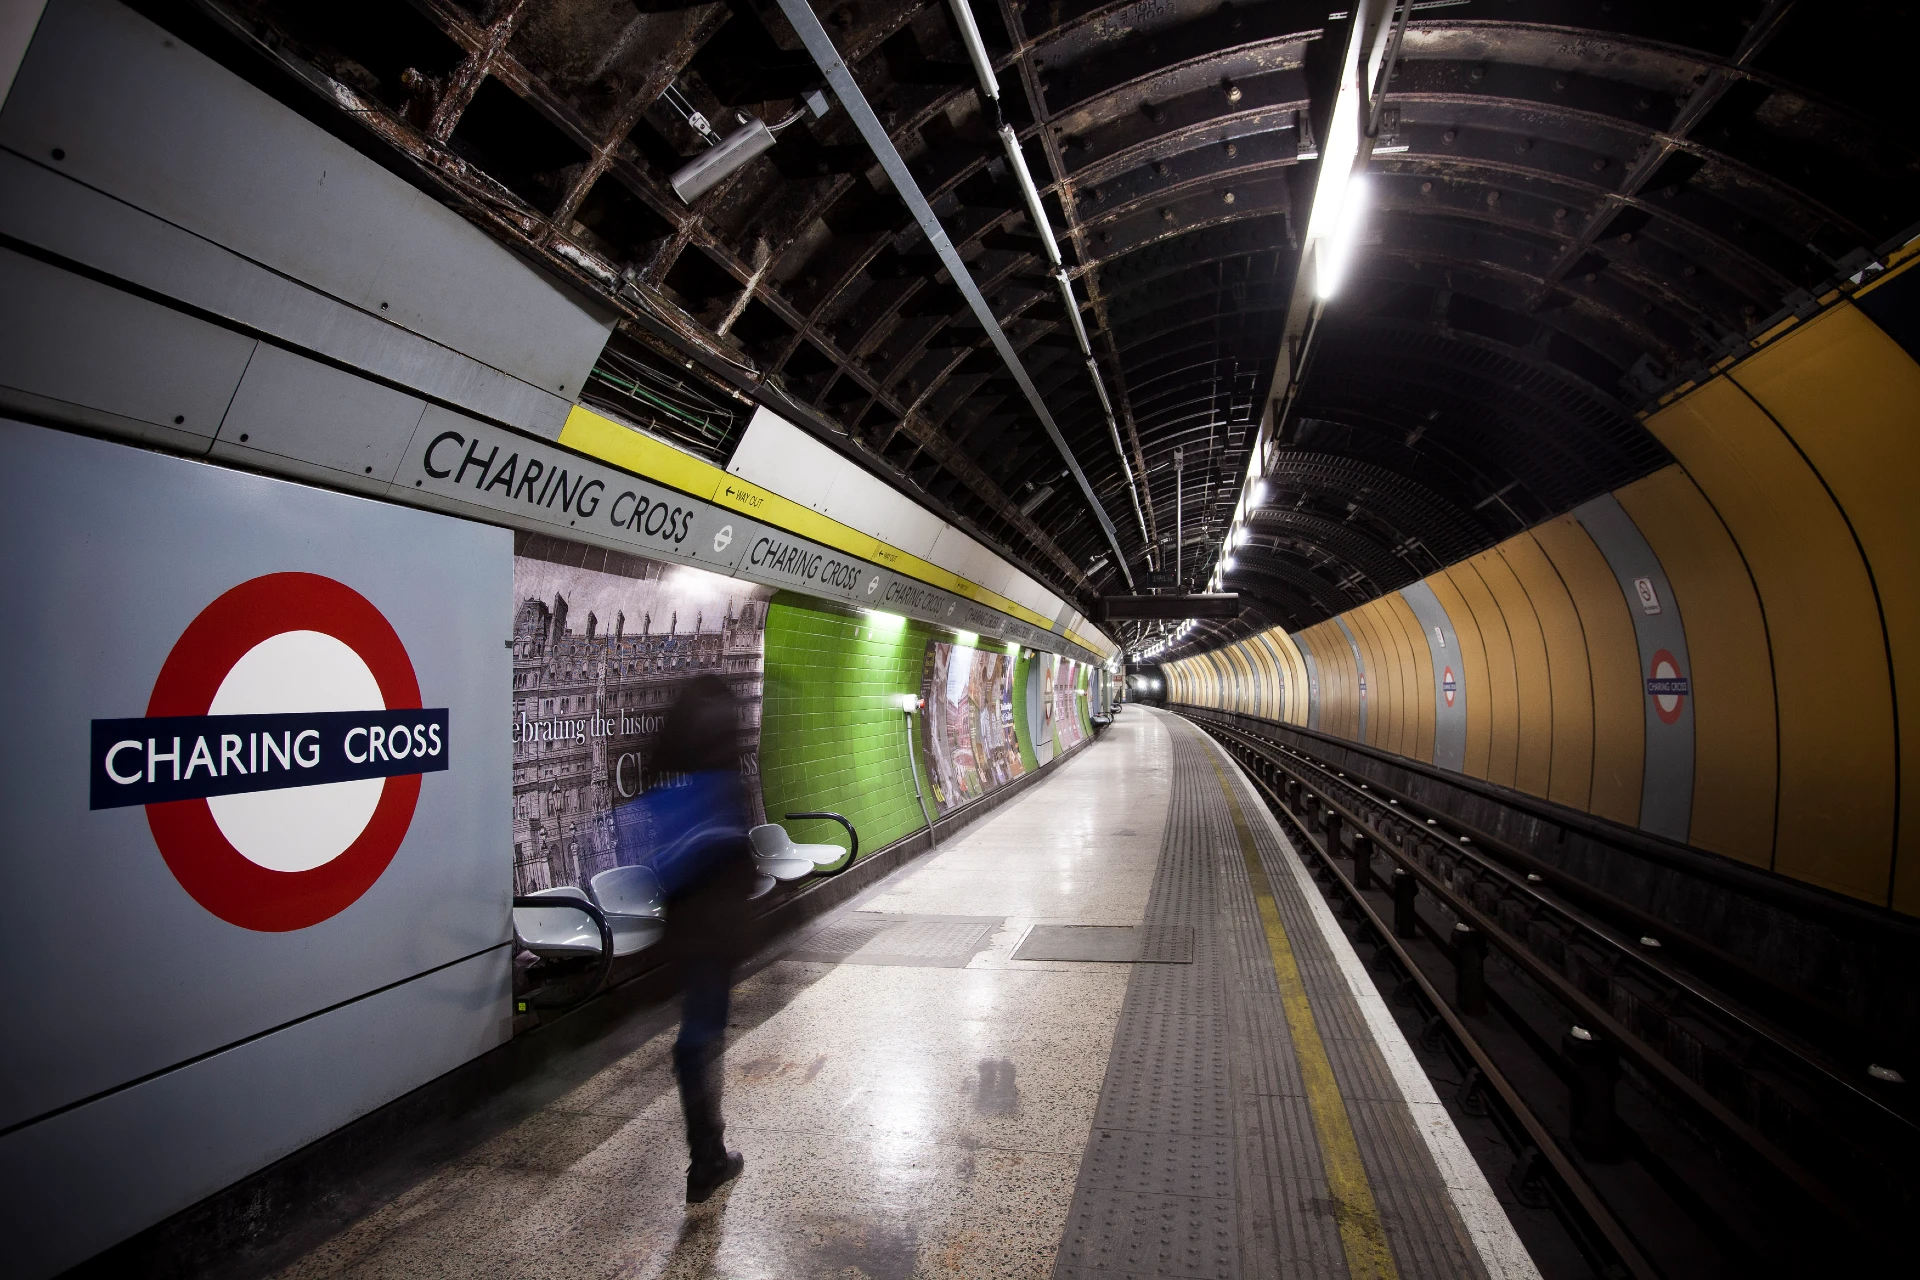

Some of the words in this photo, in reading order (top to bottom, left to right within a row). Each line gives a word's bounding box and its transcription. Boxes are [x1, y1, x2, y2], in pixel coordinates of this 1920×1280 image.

[424, 431, 605, 518] CHARING
[610, 490, 694, 543] CROSS
[735, 489, 750, 503] WAY
[750, 495, 764, 509] OUT
[750, 537, 823, 579] CHARING
[820, 559, 862, 591] CROSS
[885, 581, 925, 608] CHARING
[1648, 682, 1670, 691] CHARING
[1671, 682, 1687, 691] CROSS
[590, 708, 615, 737] the
[105, 729, 320, 785] CHARING
[344, 723, 442, 764] CROSS
